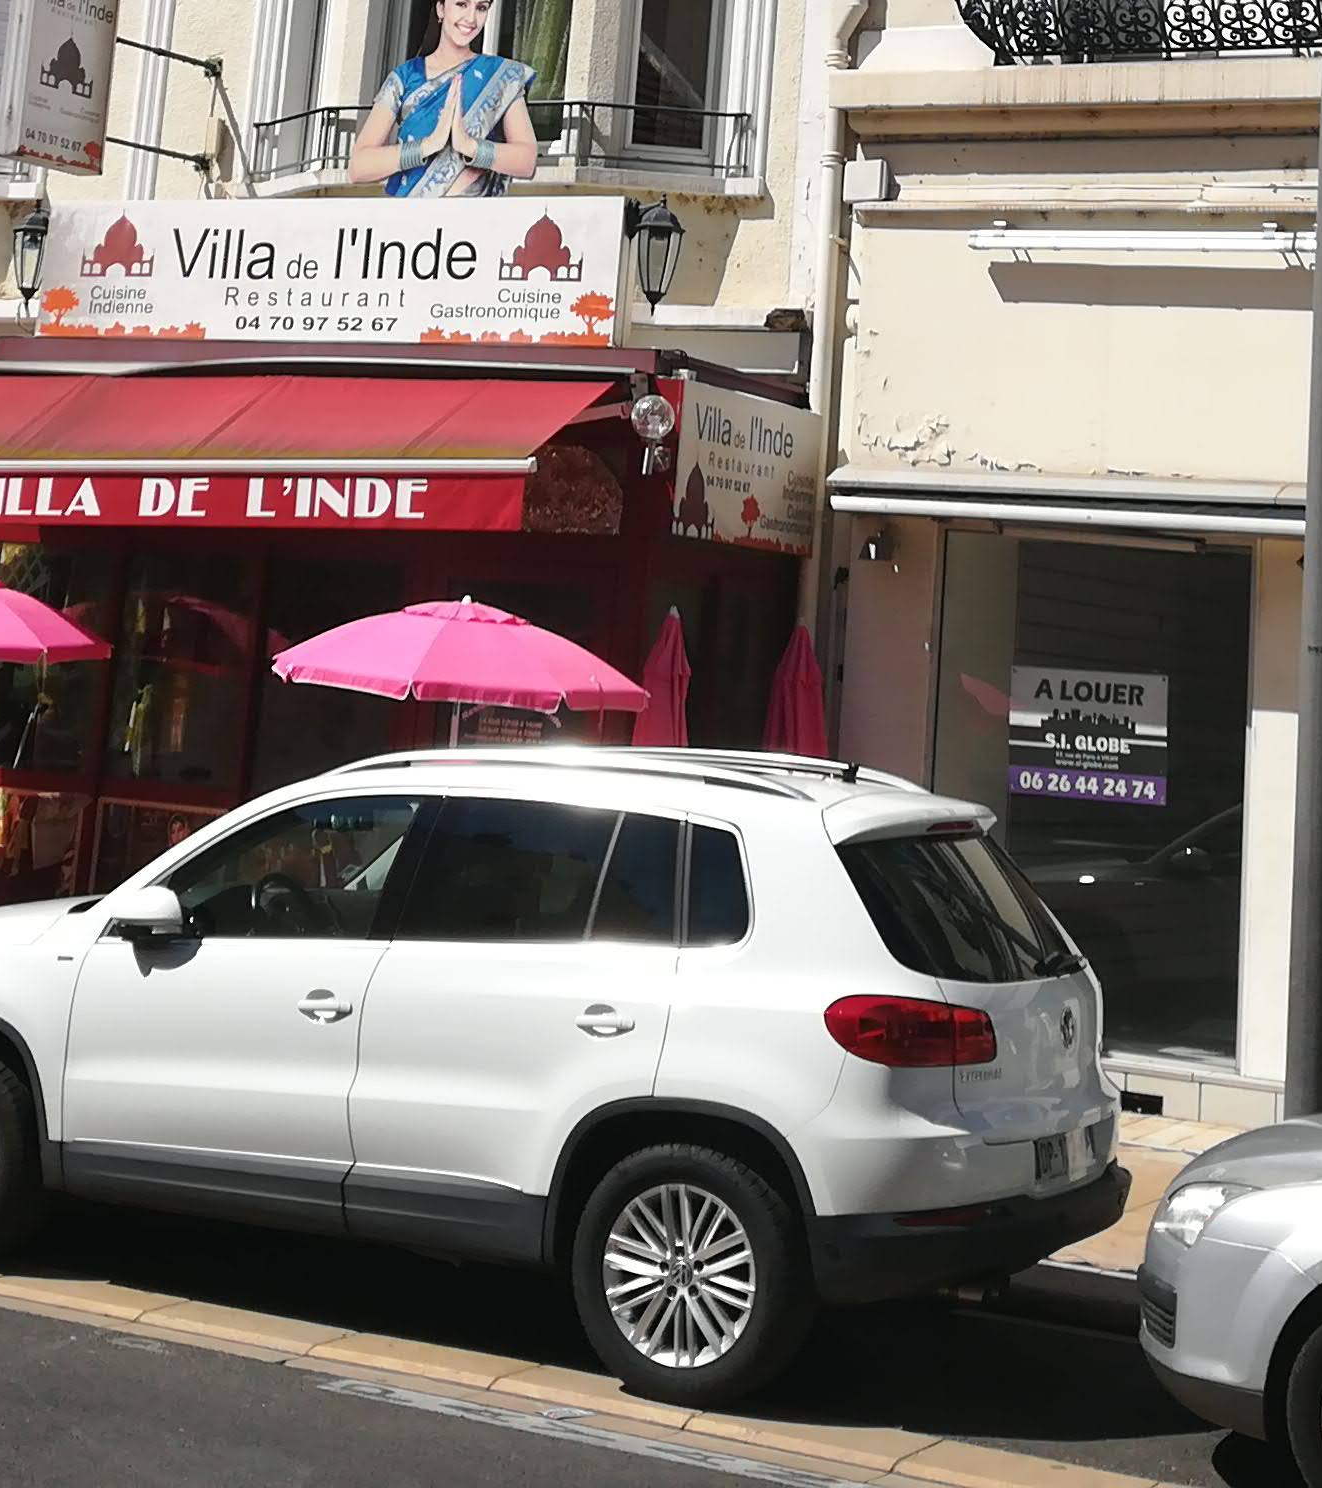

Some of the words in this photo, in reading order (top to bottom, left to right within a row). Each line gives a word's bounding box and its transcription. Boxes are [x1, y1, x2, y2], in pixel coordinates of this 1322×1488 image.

[25, 127, 35, 140] 04
[60, 137, 70, 150] 52
[173, 228, 275, 281] Villa
[285, 254, 319, 280] de
[334, 228, 478, 281] l'Inde
[90, 285, 147, 301] Cuisine
[224, 286, 407, 309] Restaurant
[497, 288, 562, 304] Cuisine
[87, 299, 154, 315] Indienne
[429, 303, 561, 321] Gastronomique
[234, 316, 261, 331] 04
[269, 316, 294, 331] 70
[302, 317, 328, 332] 97
[336, 317, 363, 332] 52
[371, 317, 399, 332] 67
[696, 402, 732, 446] Villa
[734, 430, 746, 450] de
[749, 415, 794, 458] l'Inde
[708, 450, 775, 480] Restaurant
[138, 478, 210, 518] DE
[245, 477, 429, 520] L'INDE
[1034, 678, 1054, 700] A
[1060, 679, 1145, 707] LOUER
[1044, 732, 1071, 750] S.I.
[1074, 734, 1131, 755] GLOBE
[1019, 770, 1044, 790] 06
[1047, 773, 1072, 793] 26
[1074, 775, 1099, 796] 44
[1102, 777, 1127, 798] 24
[1132, 779, 1156, 800] 74
